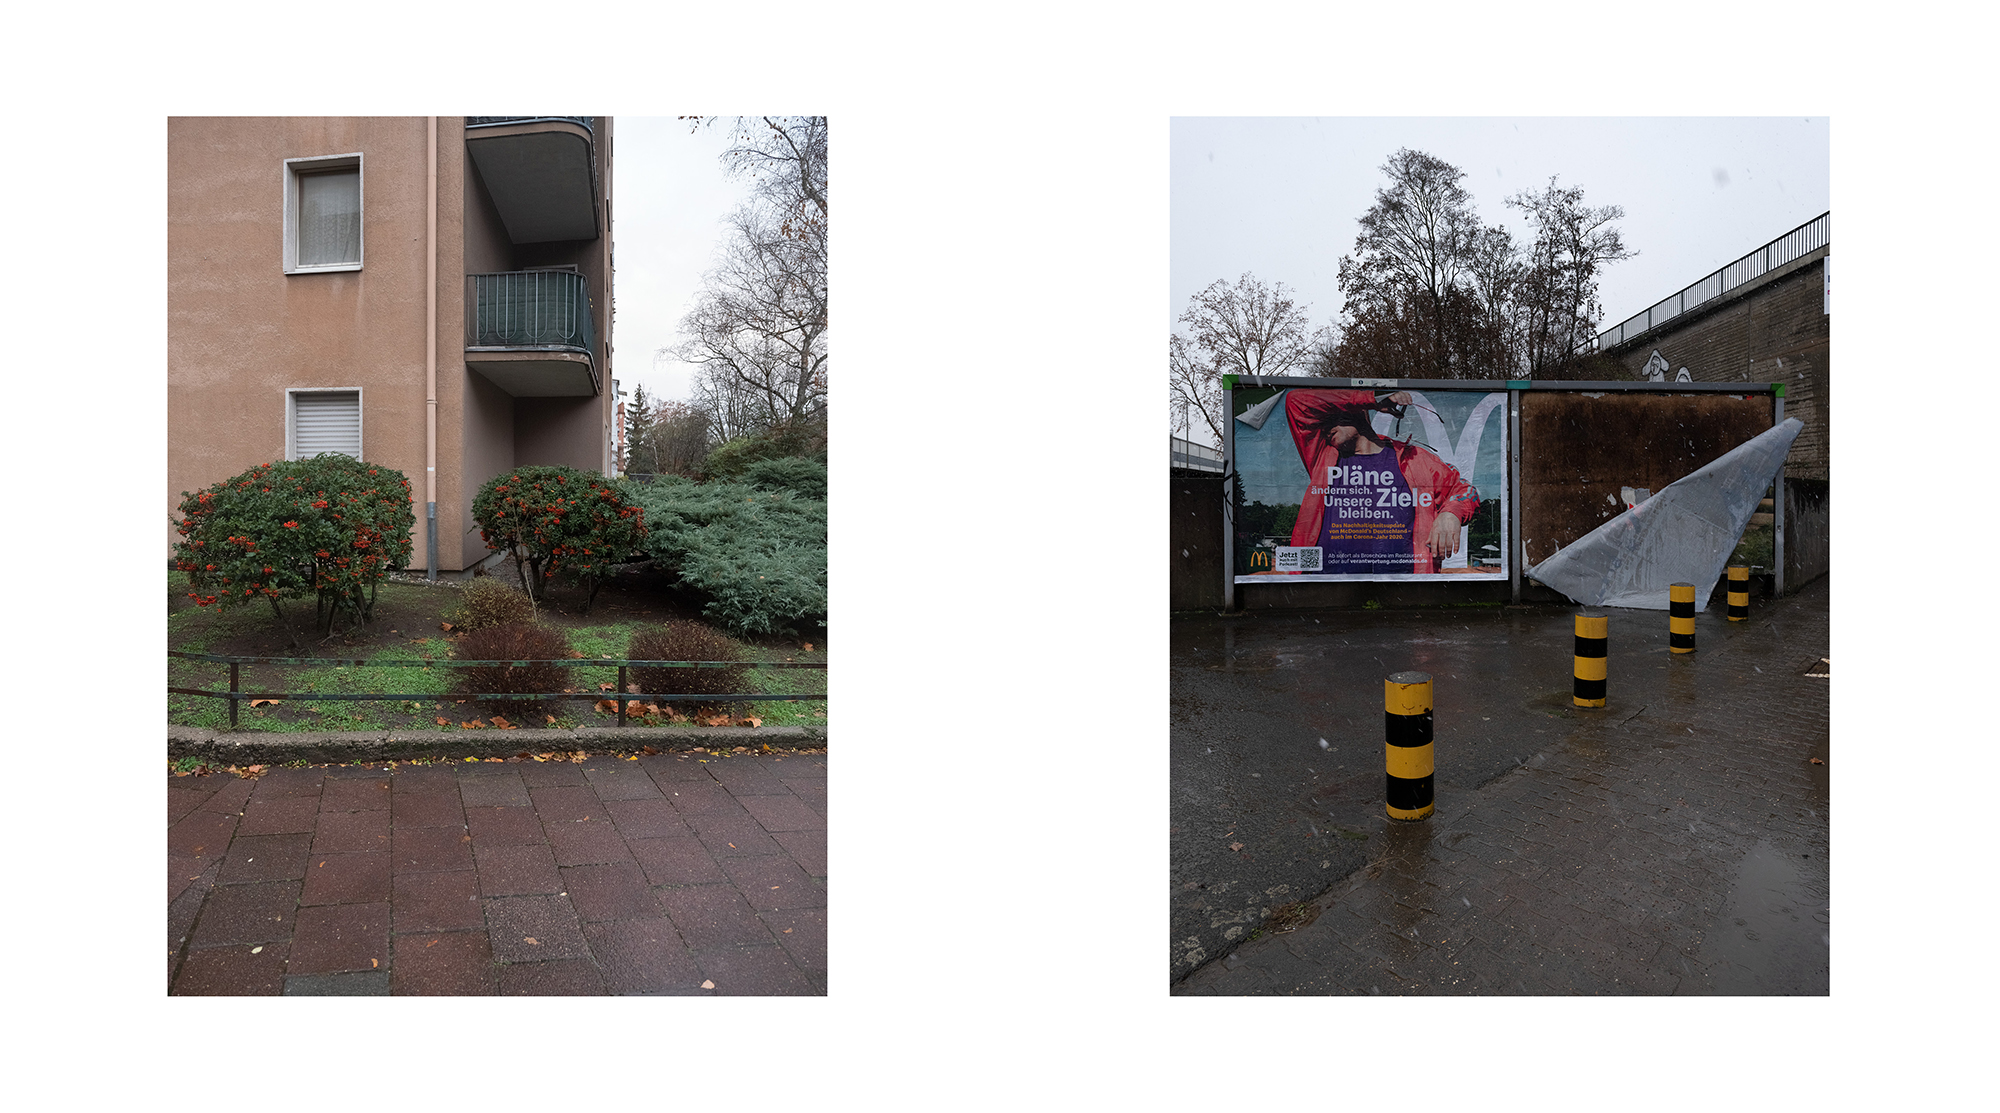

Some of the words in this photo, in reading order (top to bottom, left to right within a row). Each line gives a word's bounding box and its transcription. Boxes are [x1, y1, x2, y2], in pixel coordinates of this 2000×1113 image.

[1328, 465, 1394, 485] Pläne
[1311, 486, 1346, 494] ändern
[1349, 486, 1372, 494] sich.
[1324, 496, 1372, 507] Unsere
[1377, 487, 1432, 507] Ziele
[1339, 508, 1393, 518] bleiben.
